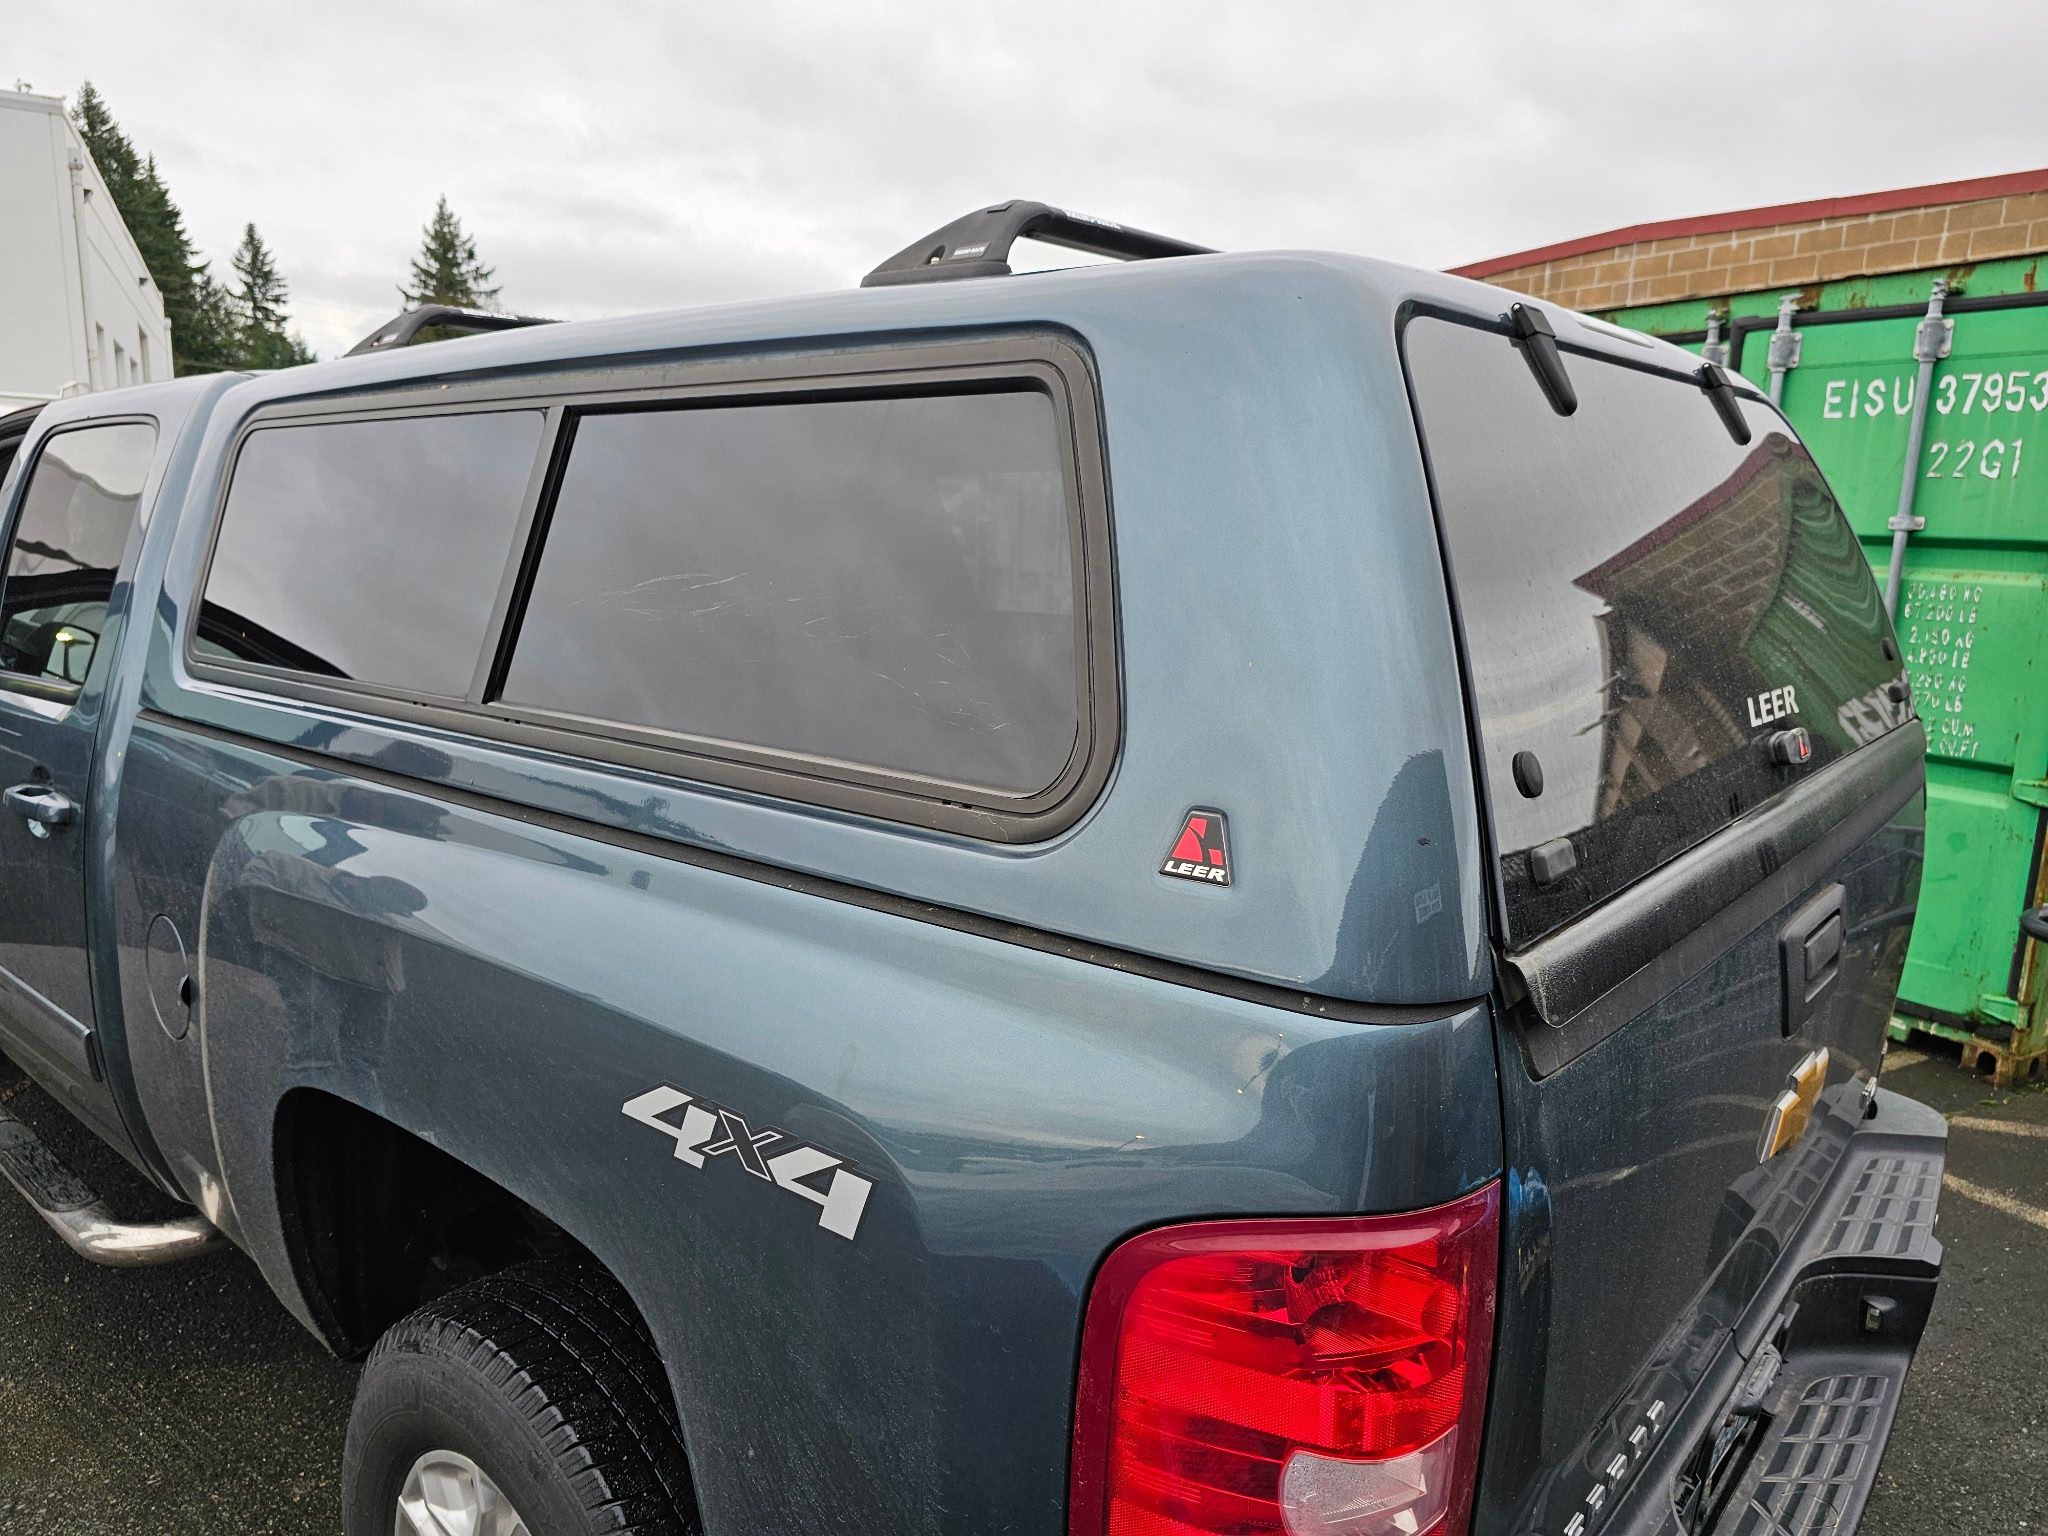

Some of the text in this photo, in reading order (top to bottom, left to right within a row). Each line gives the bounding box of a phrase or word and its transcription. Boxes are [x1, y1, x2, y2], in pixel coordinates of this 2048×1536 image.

[1823, 374, 1914, 419] EISU
[1926, 438, 2022, 479] 22G1
[1747, 685, 1800, 728] LEER
[1945, 695, 1963, 713] LB
[1164, 860, 1226, 883] LEER
